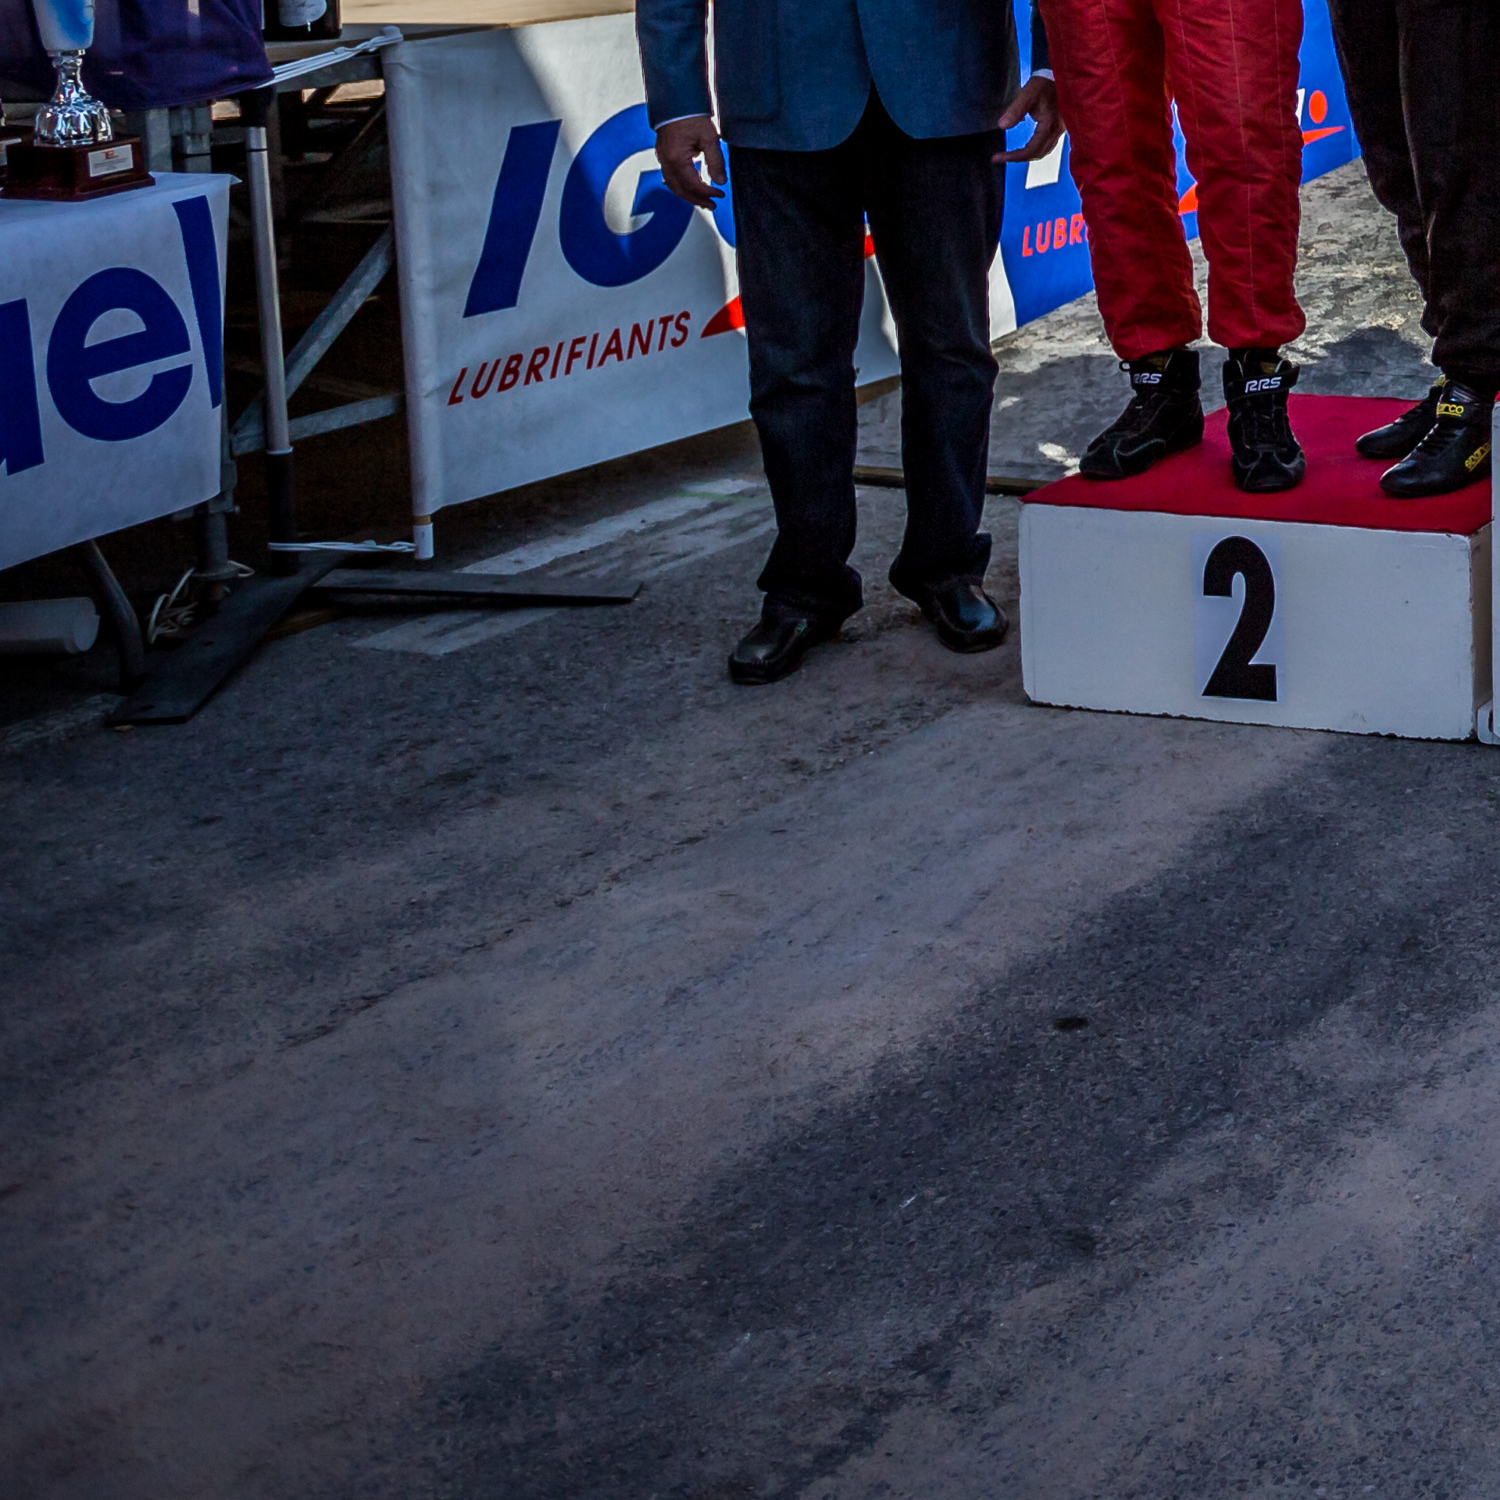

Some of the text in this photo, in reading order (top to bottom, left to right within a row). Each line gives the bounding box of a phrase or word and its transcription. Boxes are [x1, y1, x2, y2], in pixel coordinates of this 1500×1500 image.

[447, 310, 692, 407] LUBRIFIANTS
[1245, 376, 1282, 394] RRS
[1202, 535, 1278, 701] 2
